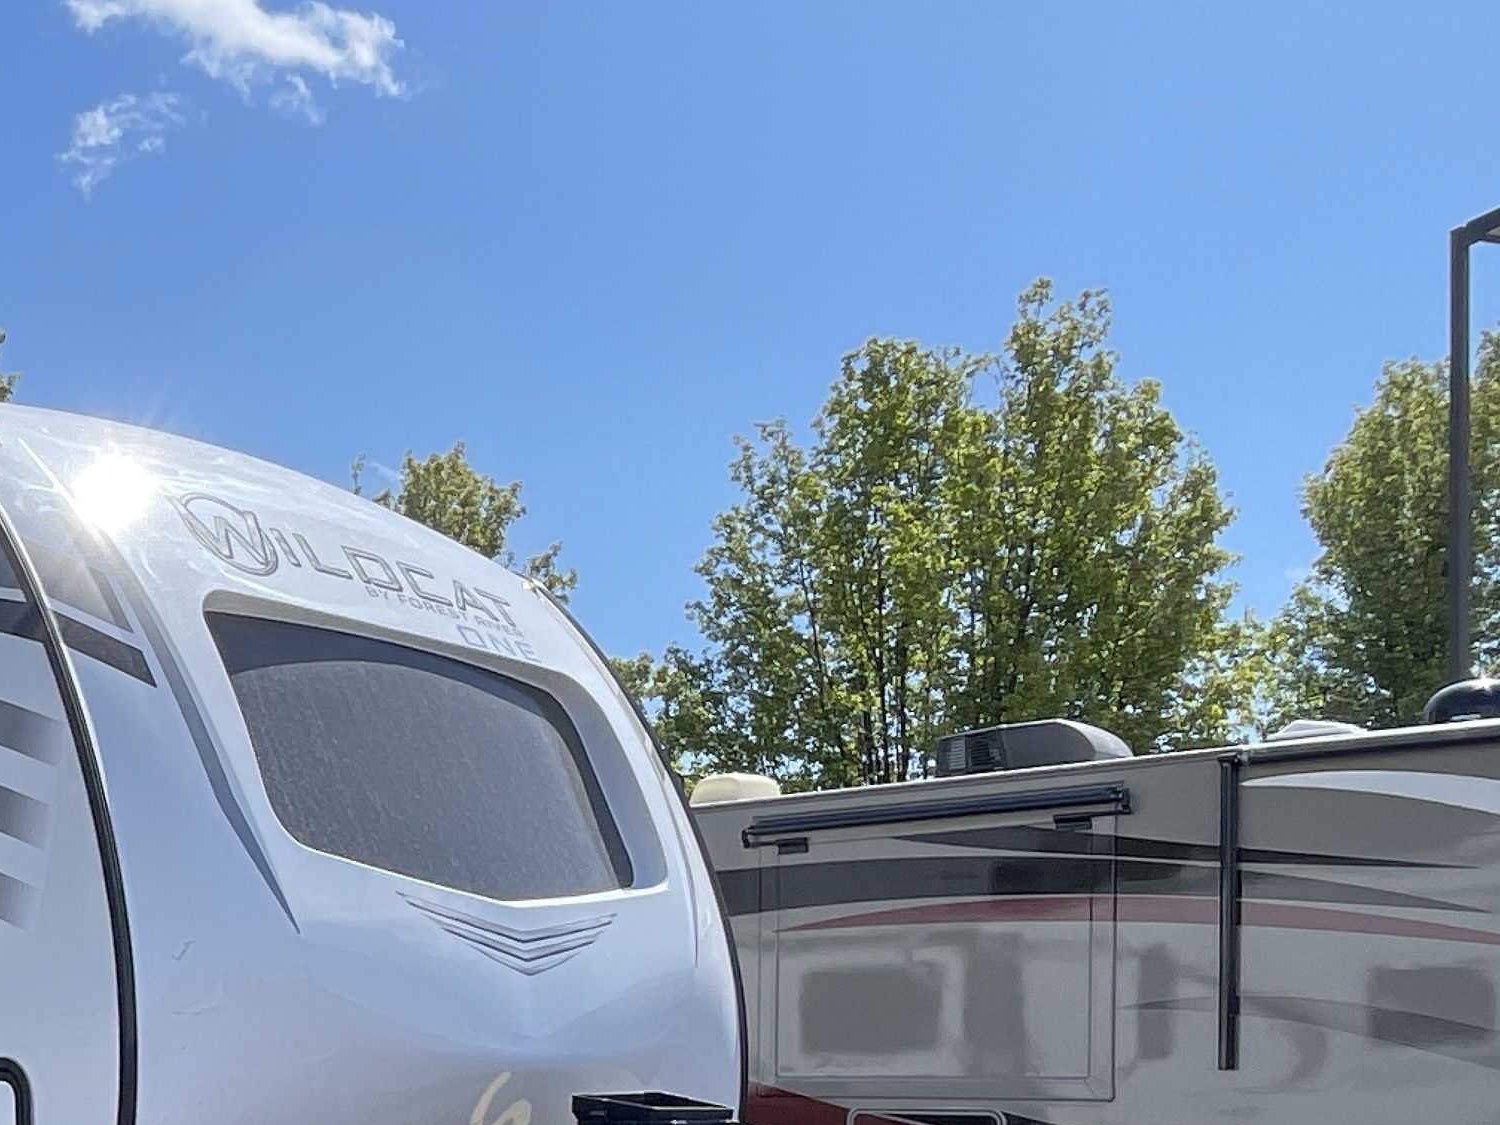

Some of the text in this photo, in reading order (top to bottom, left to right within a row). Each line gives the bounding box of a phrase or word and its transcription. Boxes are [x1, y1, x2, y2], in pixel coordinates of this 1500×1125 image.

[164, 492, 517, 628] WILDCAT
[396, 593, 469, 622] FOREST
[473, 615, 525, 640] RIVER
[456, 624, 542, 663] ONE
